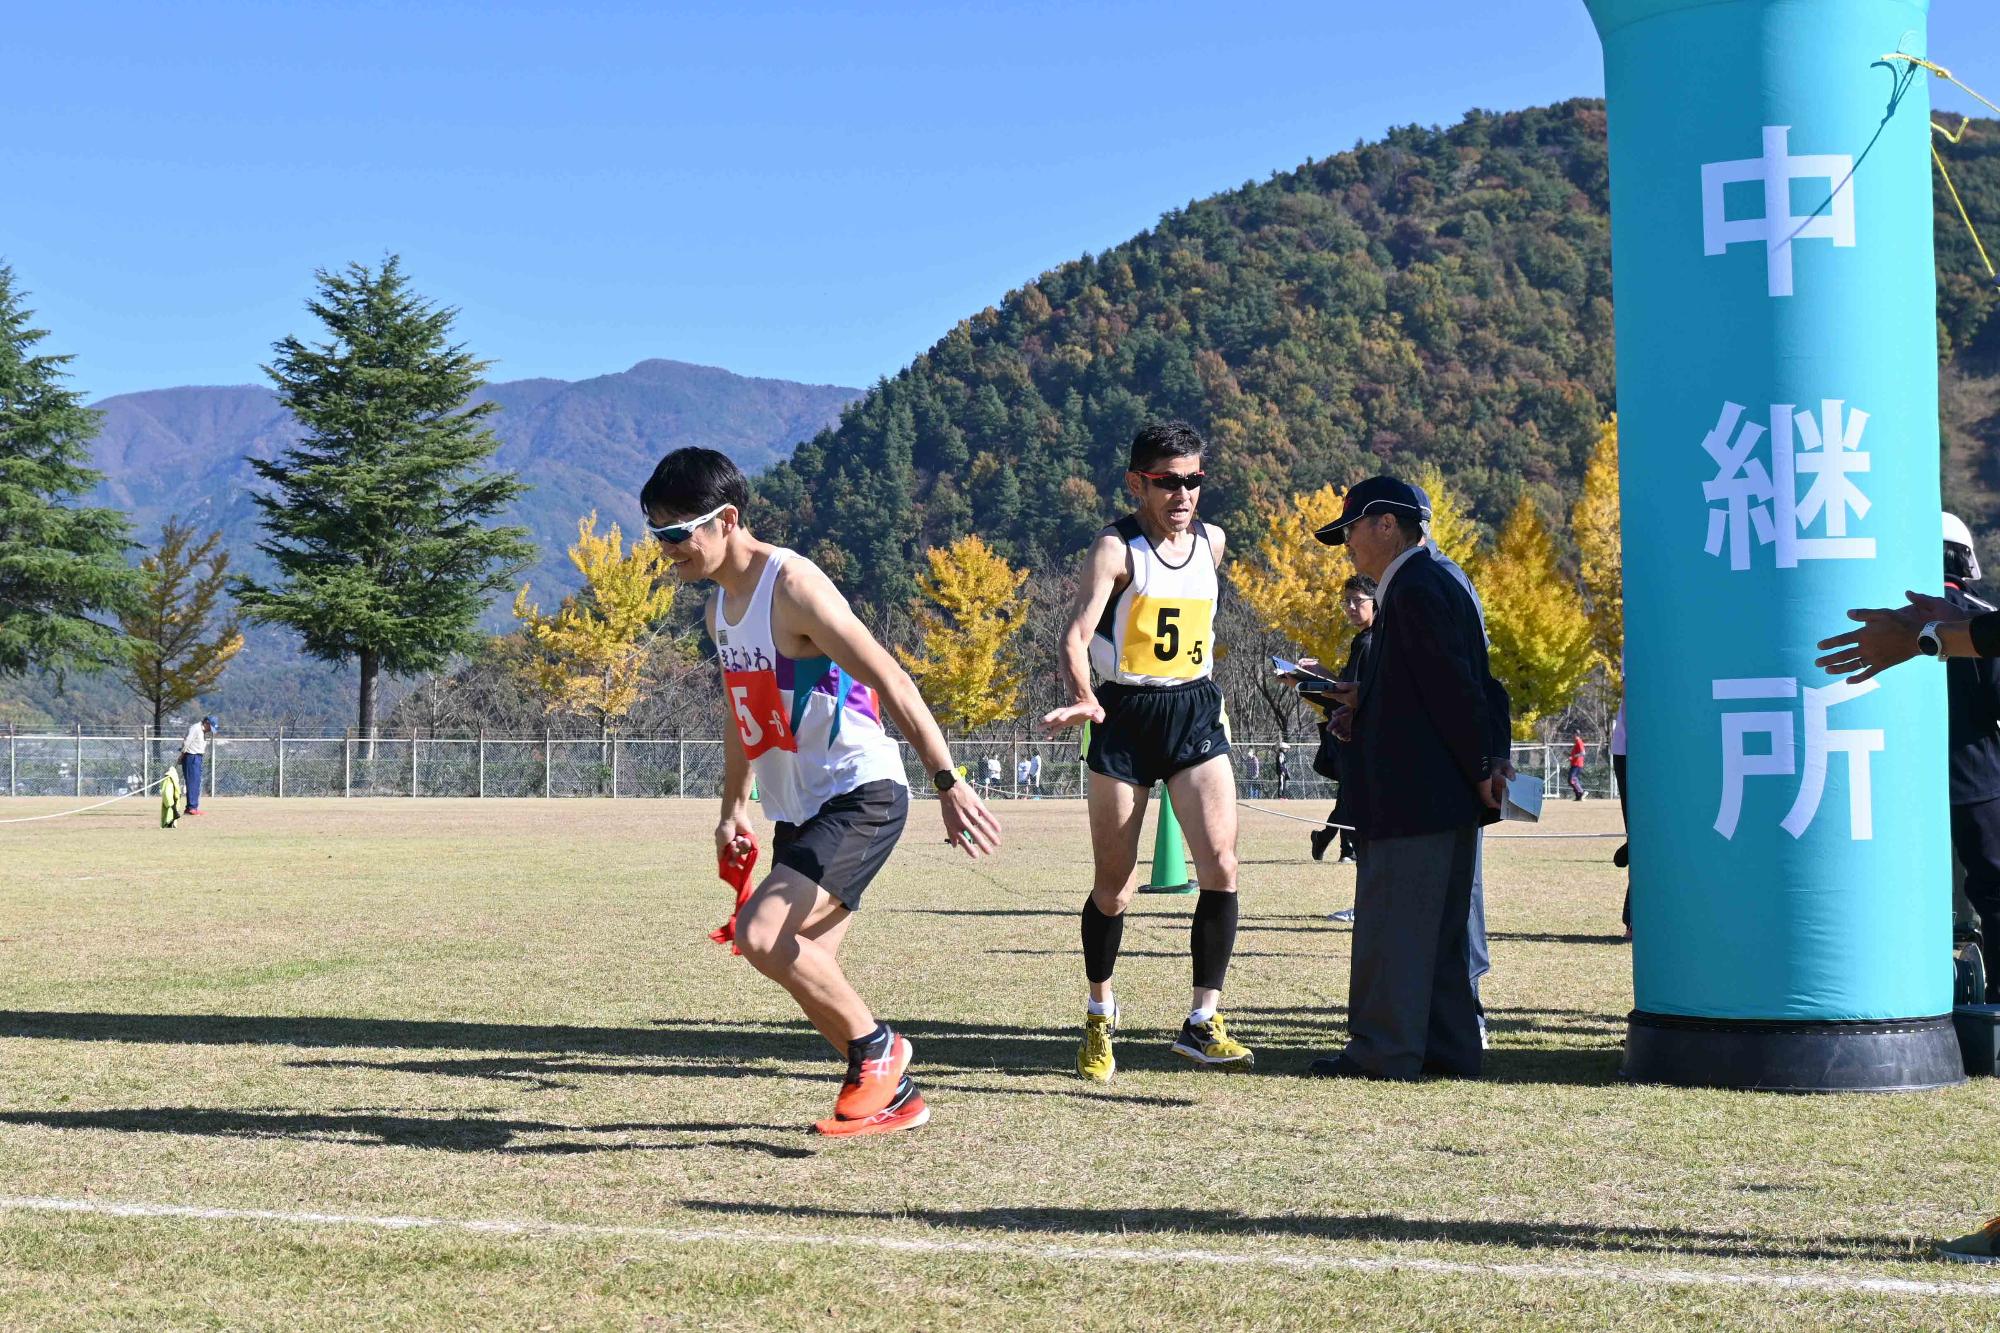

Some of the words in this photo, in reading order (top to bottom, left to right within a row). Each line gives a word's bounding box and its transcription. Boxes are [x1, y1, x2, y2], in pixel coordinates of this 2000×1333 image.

[1701, 125, 1885, 841] 中継所
[1154, 608, 1180, 661] 5
[731, 687, 763, 746] 5
